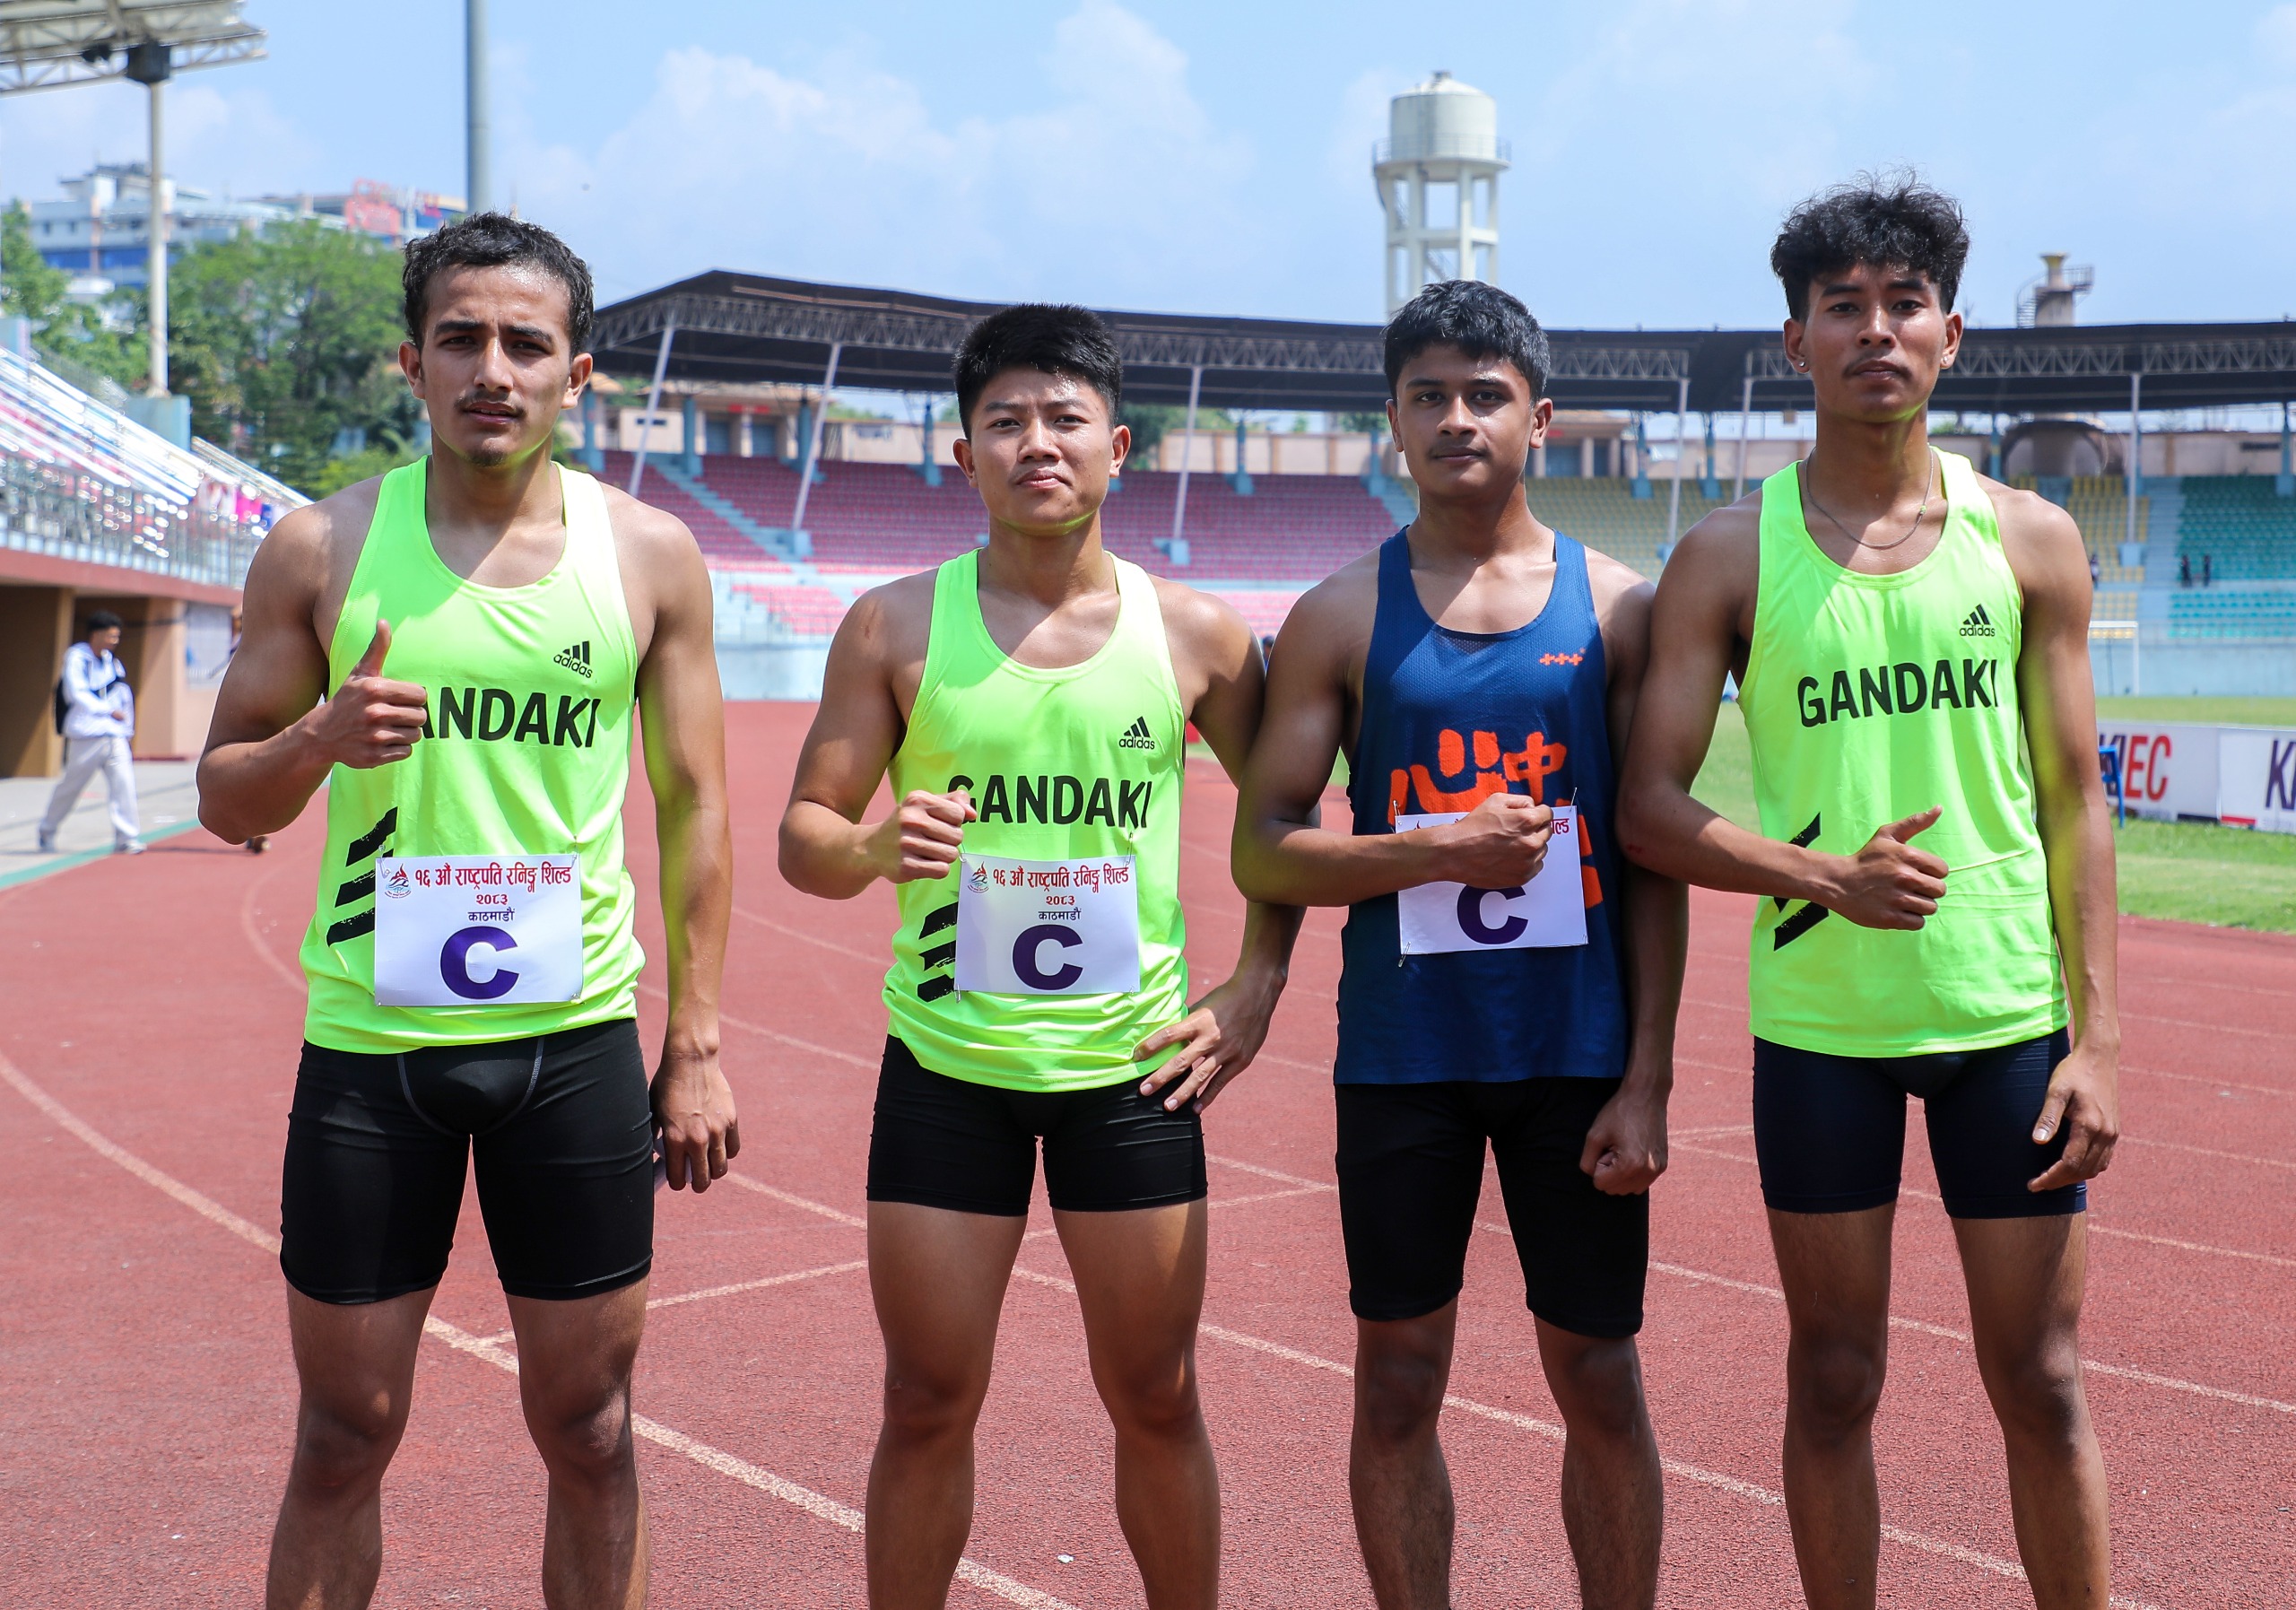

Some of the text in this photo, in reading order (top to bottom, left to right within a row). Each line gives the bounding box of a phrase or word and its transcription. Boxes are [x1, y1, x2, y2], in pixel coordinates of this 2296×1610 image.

[1959, 625, 1996, 637] adidas
[552, 653, 593, 679] adidas
[1796, 658, 1999, 728] GANDAKI
[421, 686, 602, 749] NDAKI
[1118, 735, 1155, 750] adidas
[415, 869, 430, 888] १६
[455, 862, 502, 890] राष्ट्रपति
[541, 861, 572, 885] शिल्ड
[993, 868, 1006, 887] १६
[1027, 866, 1070, 892] राष्ट्रपति
[1103, 862, 1129, 885] शिल्ड
[476, 893, 509, 905] २०८३
[1046, 895, 1075, 906] २०८३
[1457, 883, 1529, 945] C
[439, 926, 519, 1000] C
[1012, 924, 1084, 991] C
